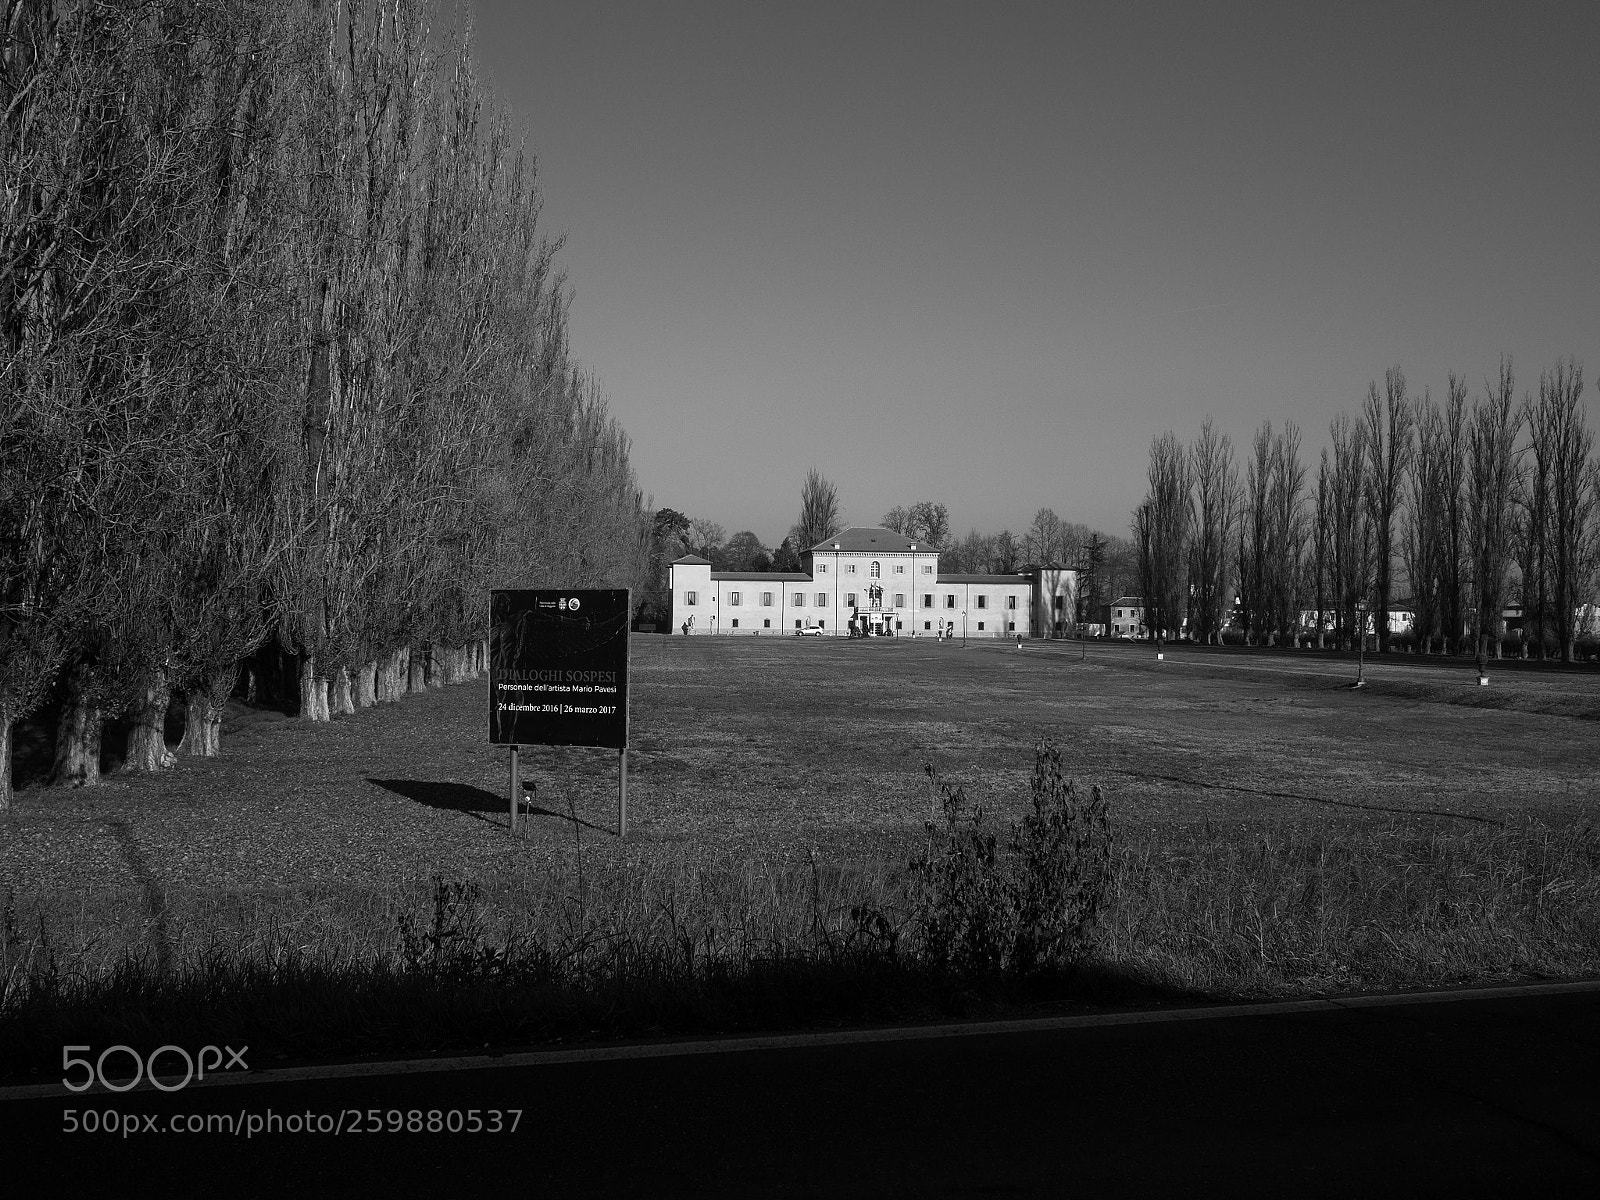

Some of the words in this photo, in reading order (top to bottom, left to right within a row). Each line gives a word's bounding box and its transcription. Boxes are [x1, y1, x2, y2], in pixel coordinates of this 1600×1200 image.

[498, 669, 562, 682] DIALOGHI
[566, 670, 617, 683] SOSPESI
[498, 683, 533, 691] Personale
[534, 684, 571, 692] dell'artista
[572, 685, 593, 693] Mario
[594, 685, 617, 693] Pavesi
[498, 702, 507, 711] 24
[508, 702, 541, 712] dicembre
[541, 704, 559, 712] 2016
[563, 704, 574, 713] 26
[574, 706, 598, 714] marzo
[598, 705, 617, 714] 2017
